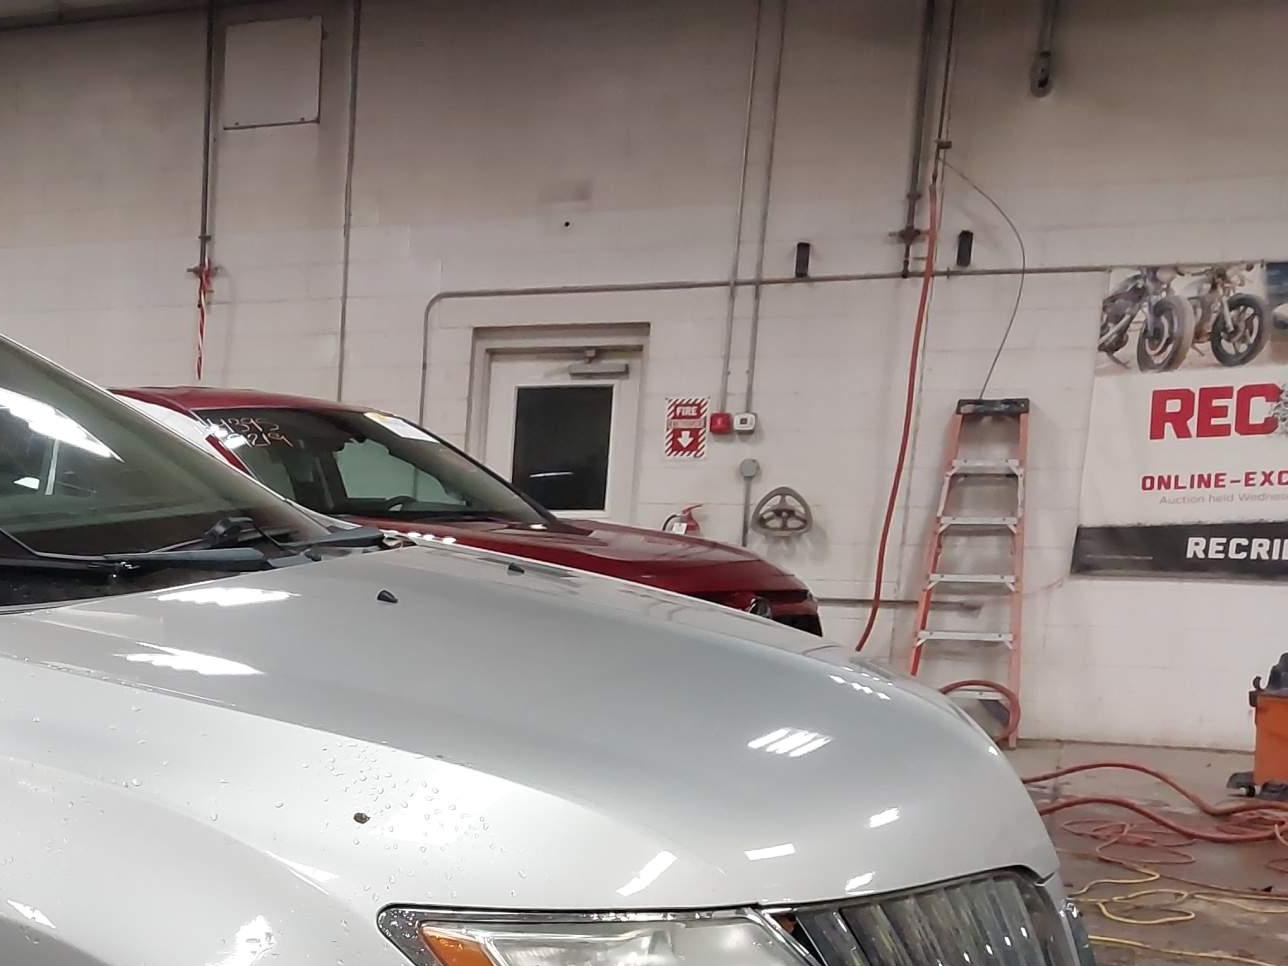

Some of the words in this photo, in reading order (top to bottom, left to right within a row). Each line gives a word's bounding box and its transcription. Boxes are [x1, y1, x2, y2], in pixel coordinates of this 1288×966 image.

[676, 406, 698, 416] FIRE
[1159, 494, 1205, 505] Auction
[1208, 493, 1235, 503] held
